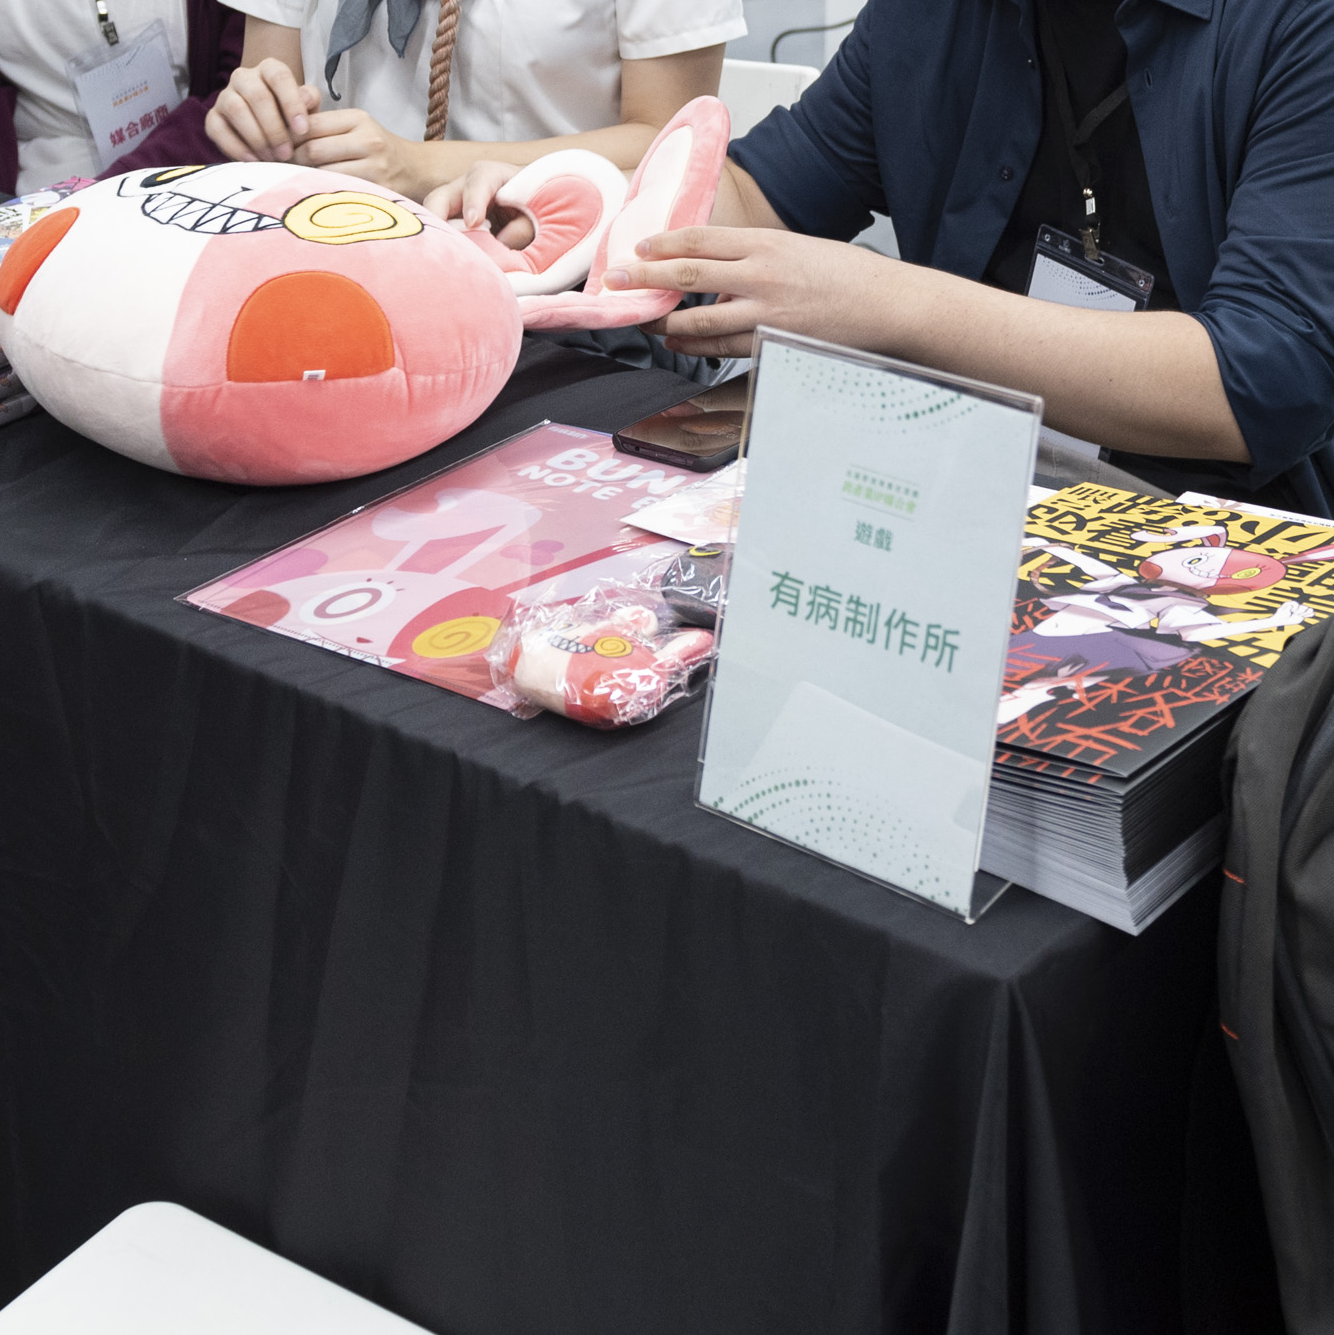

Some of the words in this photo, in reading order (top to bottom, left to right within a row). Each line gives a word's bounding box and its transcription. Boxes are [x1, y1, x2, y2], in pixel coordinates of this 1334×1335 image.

[517, 465, 624, 501] NOTE
[854, 520, 893, 553] 遊戲
[769, 570, 962, 674] 有病制作所
